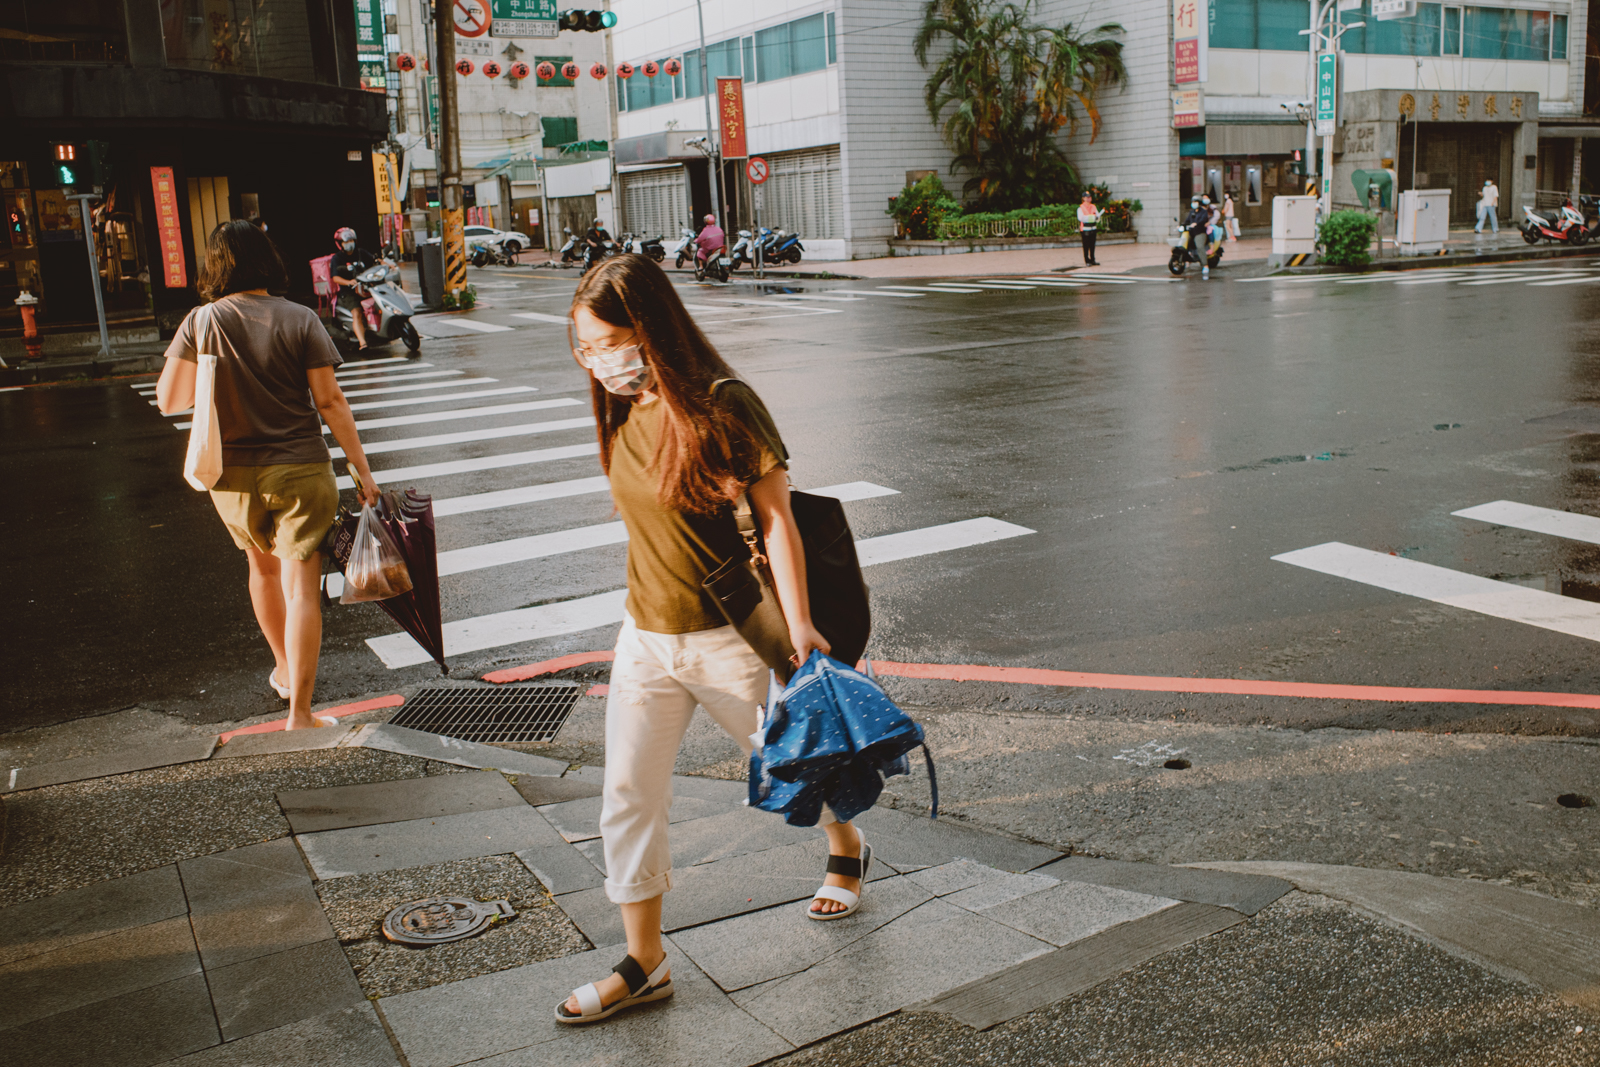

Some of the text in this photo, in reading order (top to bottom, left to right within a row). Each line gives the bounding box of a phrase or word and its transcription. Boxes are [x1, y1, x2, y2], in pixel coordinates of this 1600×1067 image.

[510, 0, 550, 10] 中山路
[511, 10, 540, 19] Zhongshan
[1176, 2, 1196, 28] 行
[1178, 42, 1195, 50] BANK
[1176, 55, 1198, 64] TAIWAN
[1321, 72, 1332, 110] 中山路
[724, 81, 739, 139] 慈濟宮
[1429, 92, 1523, 121] 臺灣銀行
[1356, 127, 1375, 139] OF
[59, 144, 74, 160] 11
[158, 181, 182, 286] 國民旅遊卡特約商店
